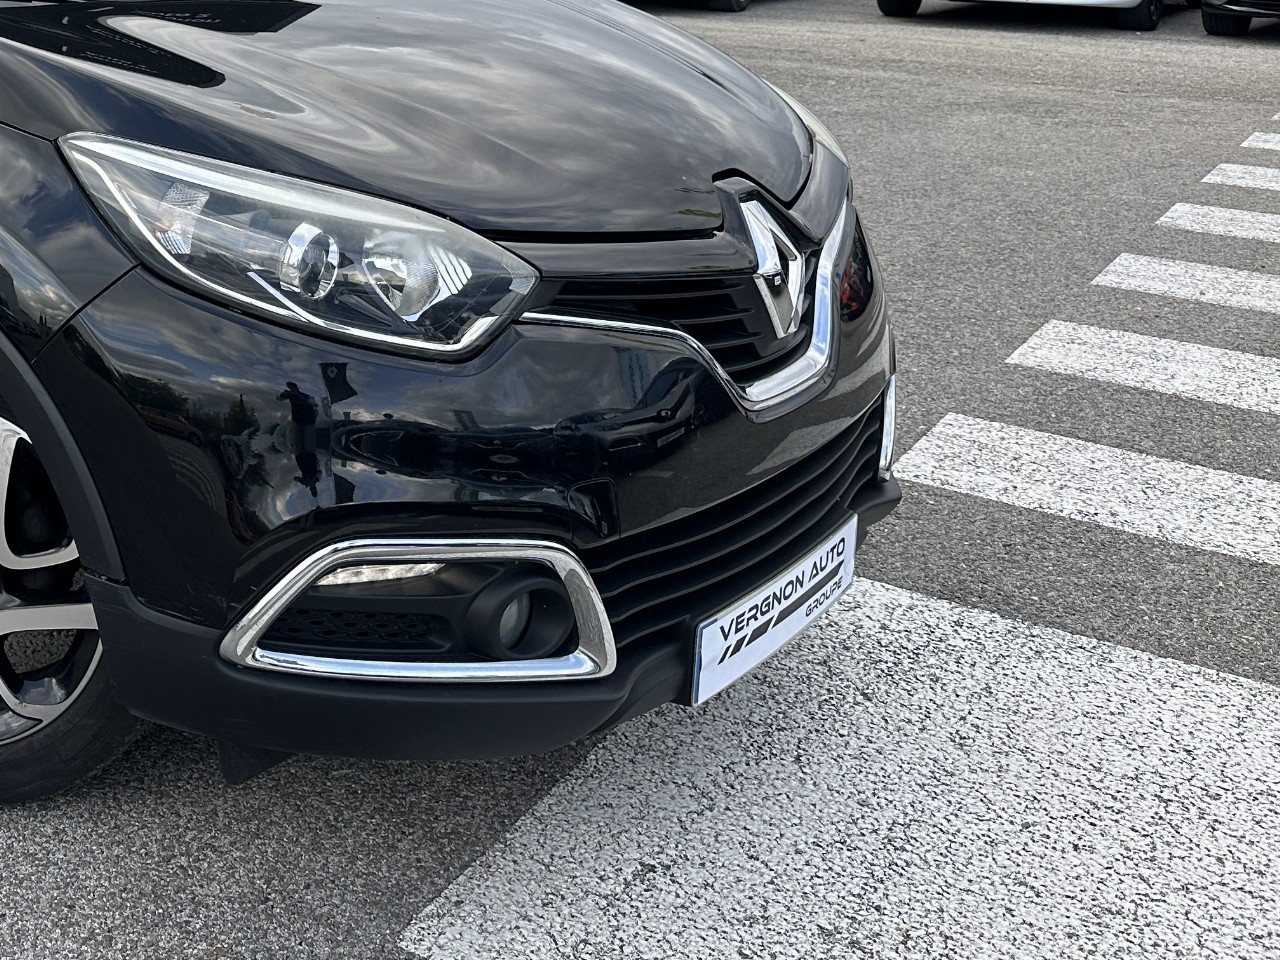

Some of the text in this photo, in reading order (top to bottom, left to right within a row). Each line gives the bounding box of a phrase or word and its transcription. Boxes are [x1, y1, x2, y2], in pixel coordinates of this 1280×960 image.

[719, 536, 846, 642] VERGNON AUTO
[805, 575, 844, 617] GROUPE
